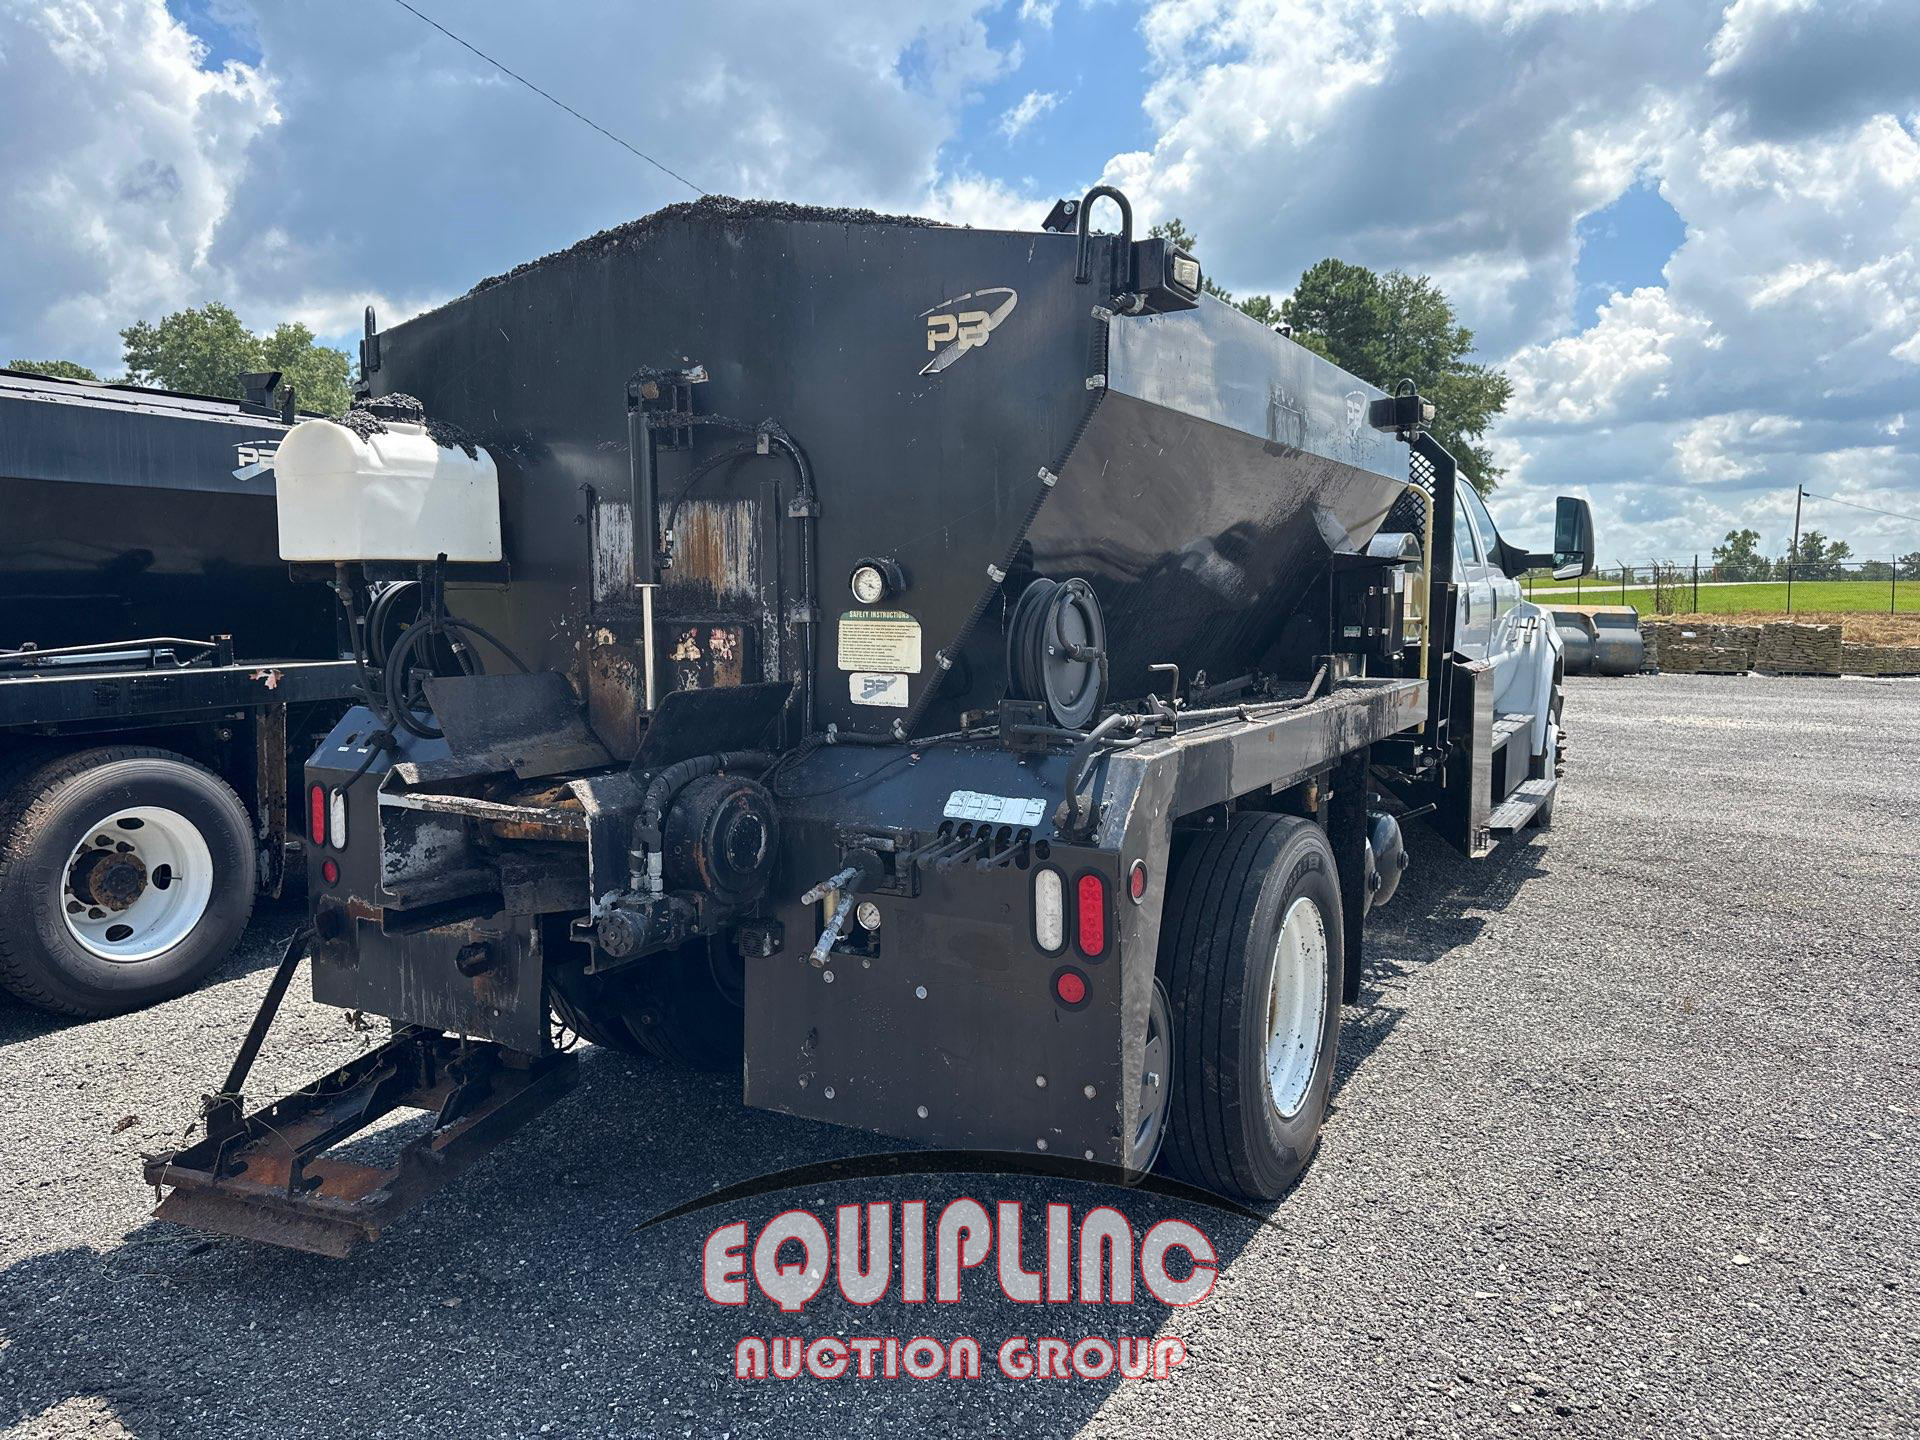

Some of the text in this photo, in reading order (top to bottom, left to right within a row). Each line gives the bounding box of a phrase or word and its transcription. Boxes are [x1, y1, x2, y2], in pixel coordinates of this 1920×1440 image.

[928, 310, 992, 352] PB
[849, 610, 910, 619] SAFETY INSTRUCTIONS
